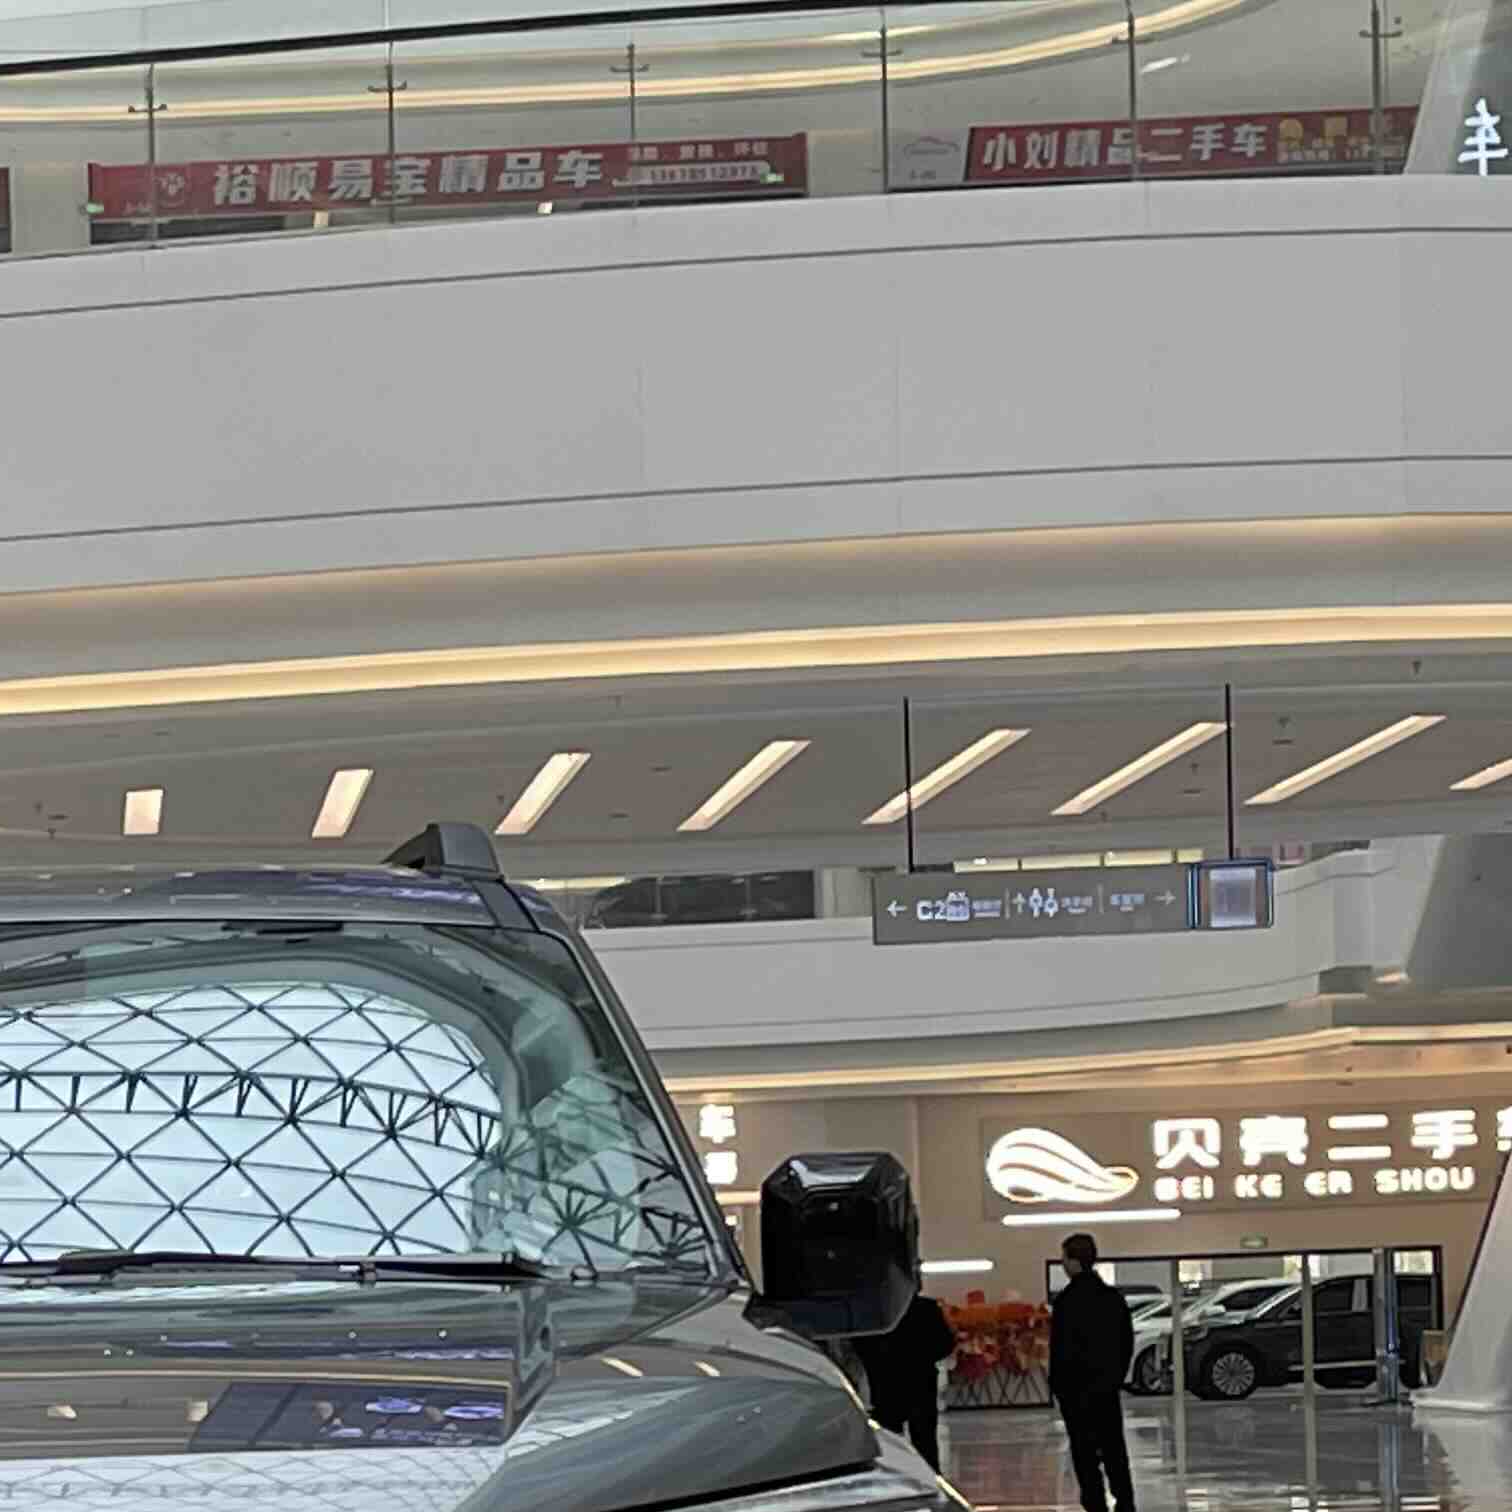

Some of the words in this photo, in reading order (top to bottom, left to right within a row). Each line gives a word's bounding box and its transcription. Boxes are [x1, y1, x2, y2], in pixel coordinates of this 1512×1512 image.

[1154, 1175, 1215, 1202] BEI
[1234, 1173, 1284, 1199] KE
[1304, 1170, 1353, 1196] ER
[1374, 1166, 1476, 1195] SHOU
